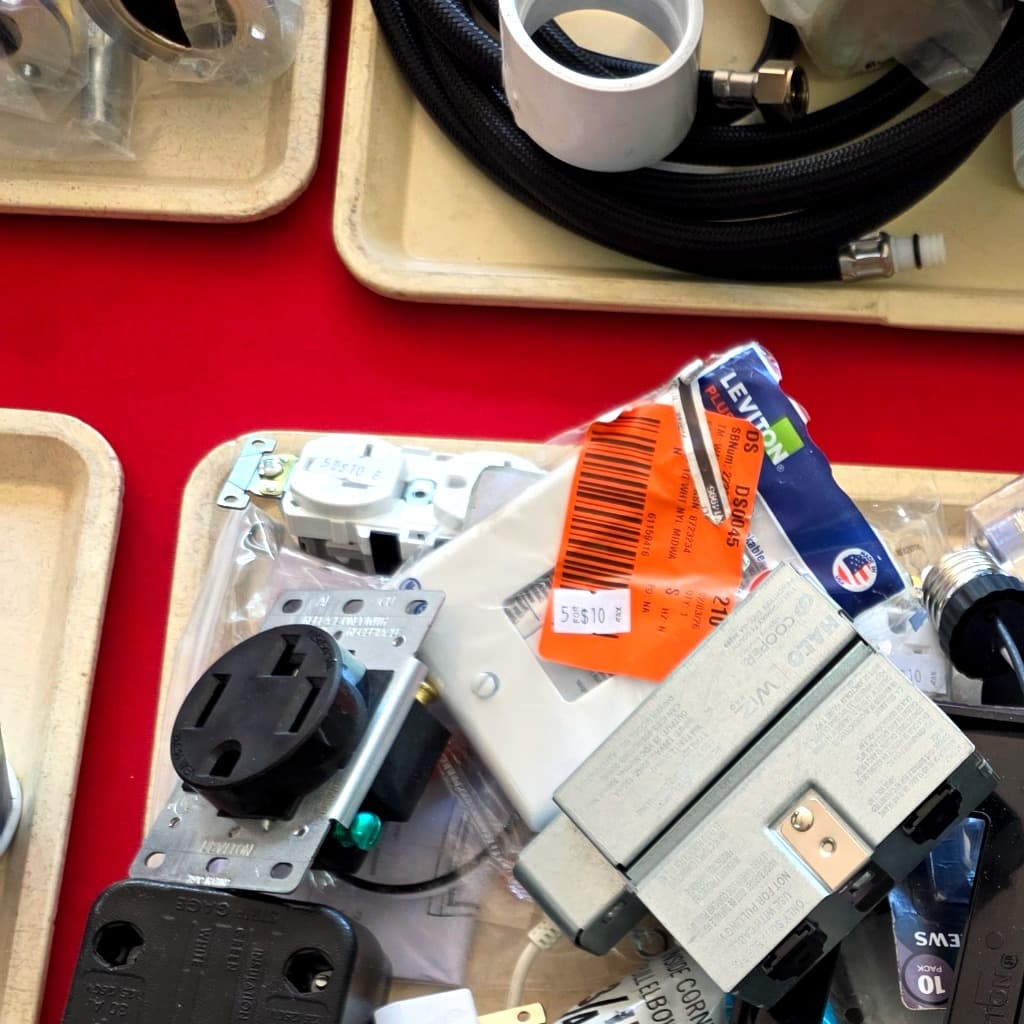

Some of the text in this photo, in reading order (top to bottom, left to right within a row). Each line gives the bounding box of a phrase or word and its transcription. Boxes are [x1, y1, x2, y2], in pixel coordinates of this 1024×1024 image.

[720, 372, 790, 466] LEVITON
[708, 429, 760, 628] DS DS0045 210
[239, 948, 263, 1020] INSULATION
[917, 964, 943, 973] PACK
[917, 975, 946, 996] 10
